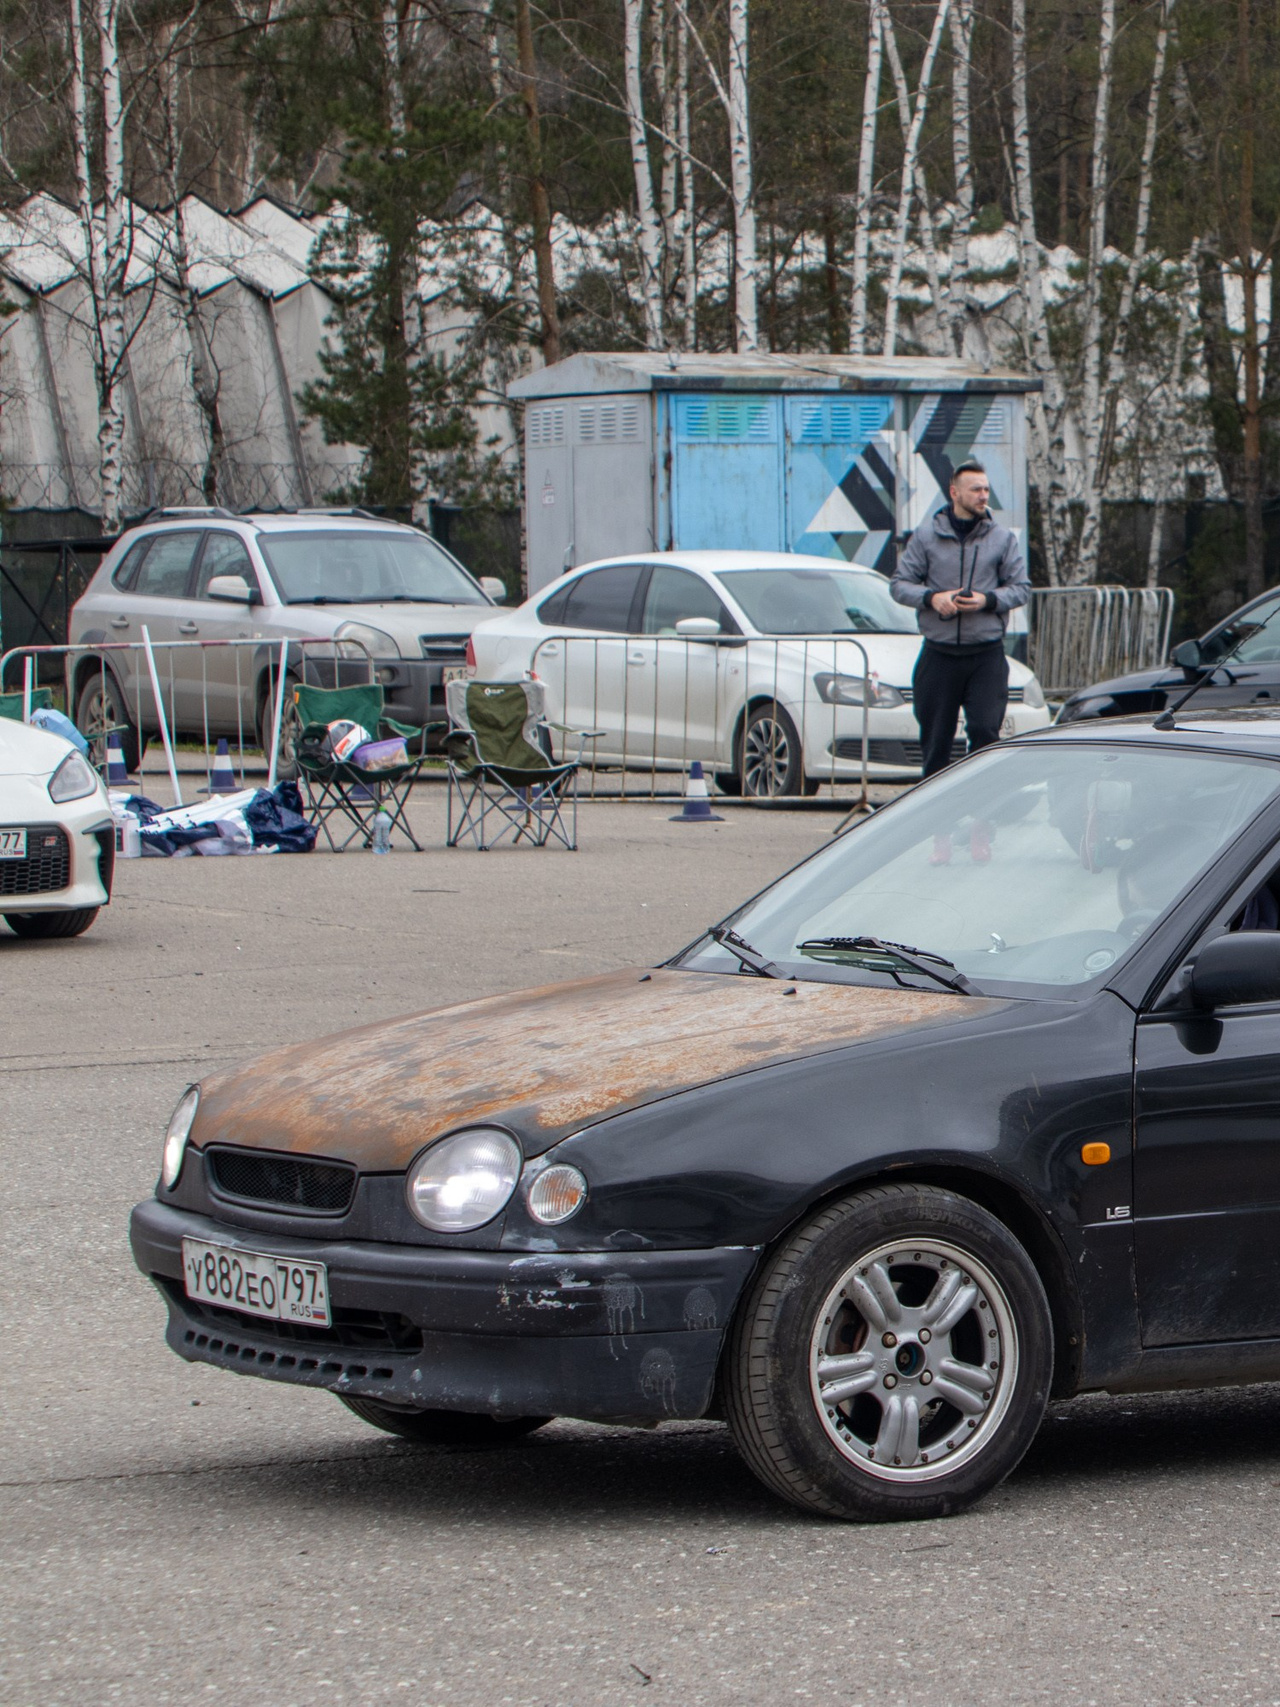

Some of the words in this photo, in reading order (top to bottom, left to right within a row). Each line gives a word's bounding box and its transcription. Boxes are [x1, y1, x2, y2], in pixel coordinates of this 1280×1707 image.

[0, 832, 21, 849] 77
[191, 1251, 276, 1310] У882ЕО
[277, 1265, 318, 1304] 797
[291, 1303, 312, 1318] RUS
